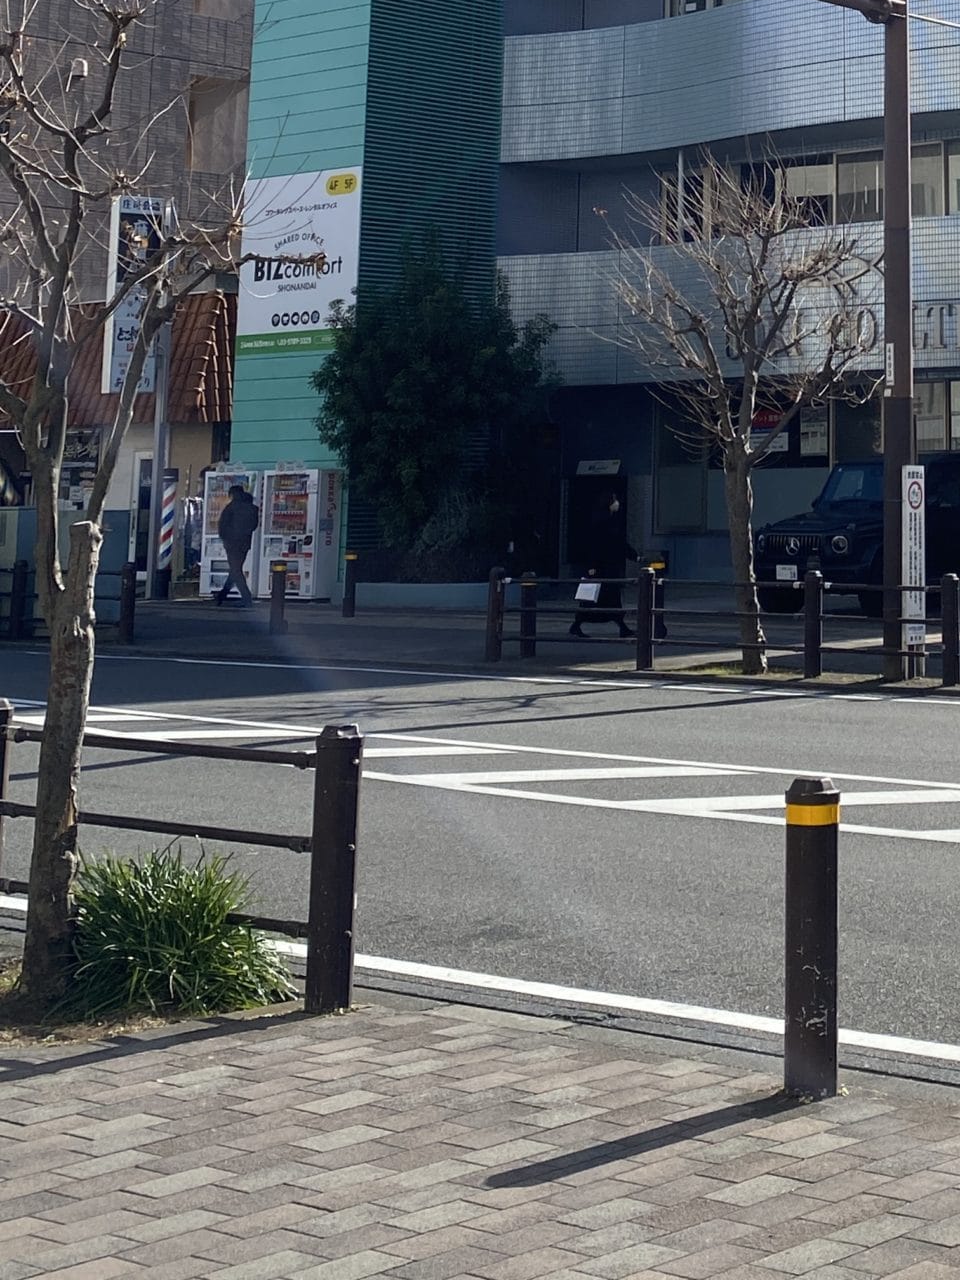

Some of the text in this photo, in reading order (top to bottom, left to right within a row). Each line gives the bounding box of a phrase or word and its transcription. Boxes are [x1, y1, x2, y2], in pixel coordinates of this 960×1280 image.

[328, 177, 354, 192] 4F 5F
[274, 233, 300, 251] SHARED
[254, 256, 343, 282] BIZcomort
[277, 281, 317, 294] SHONANDAI
